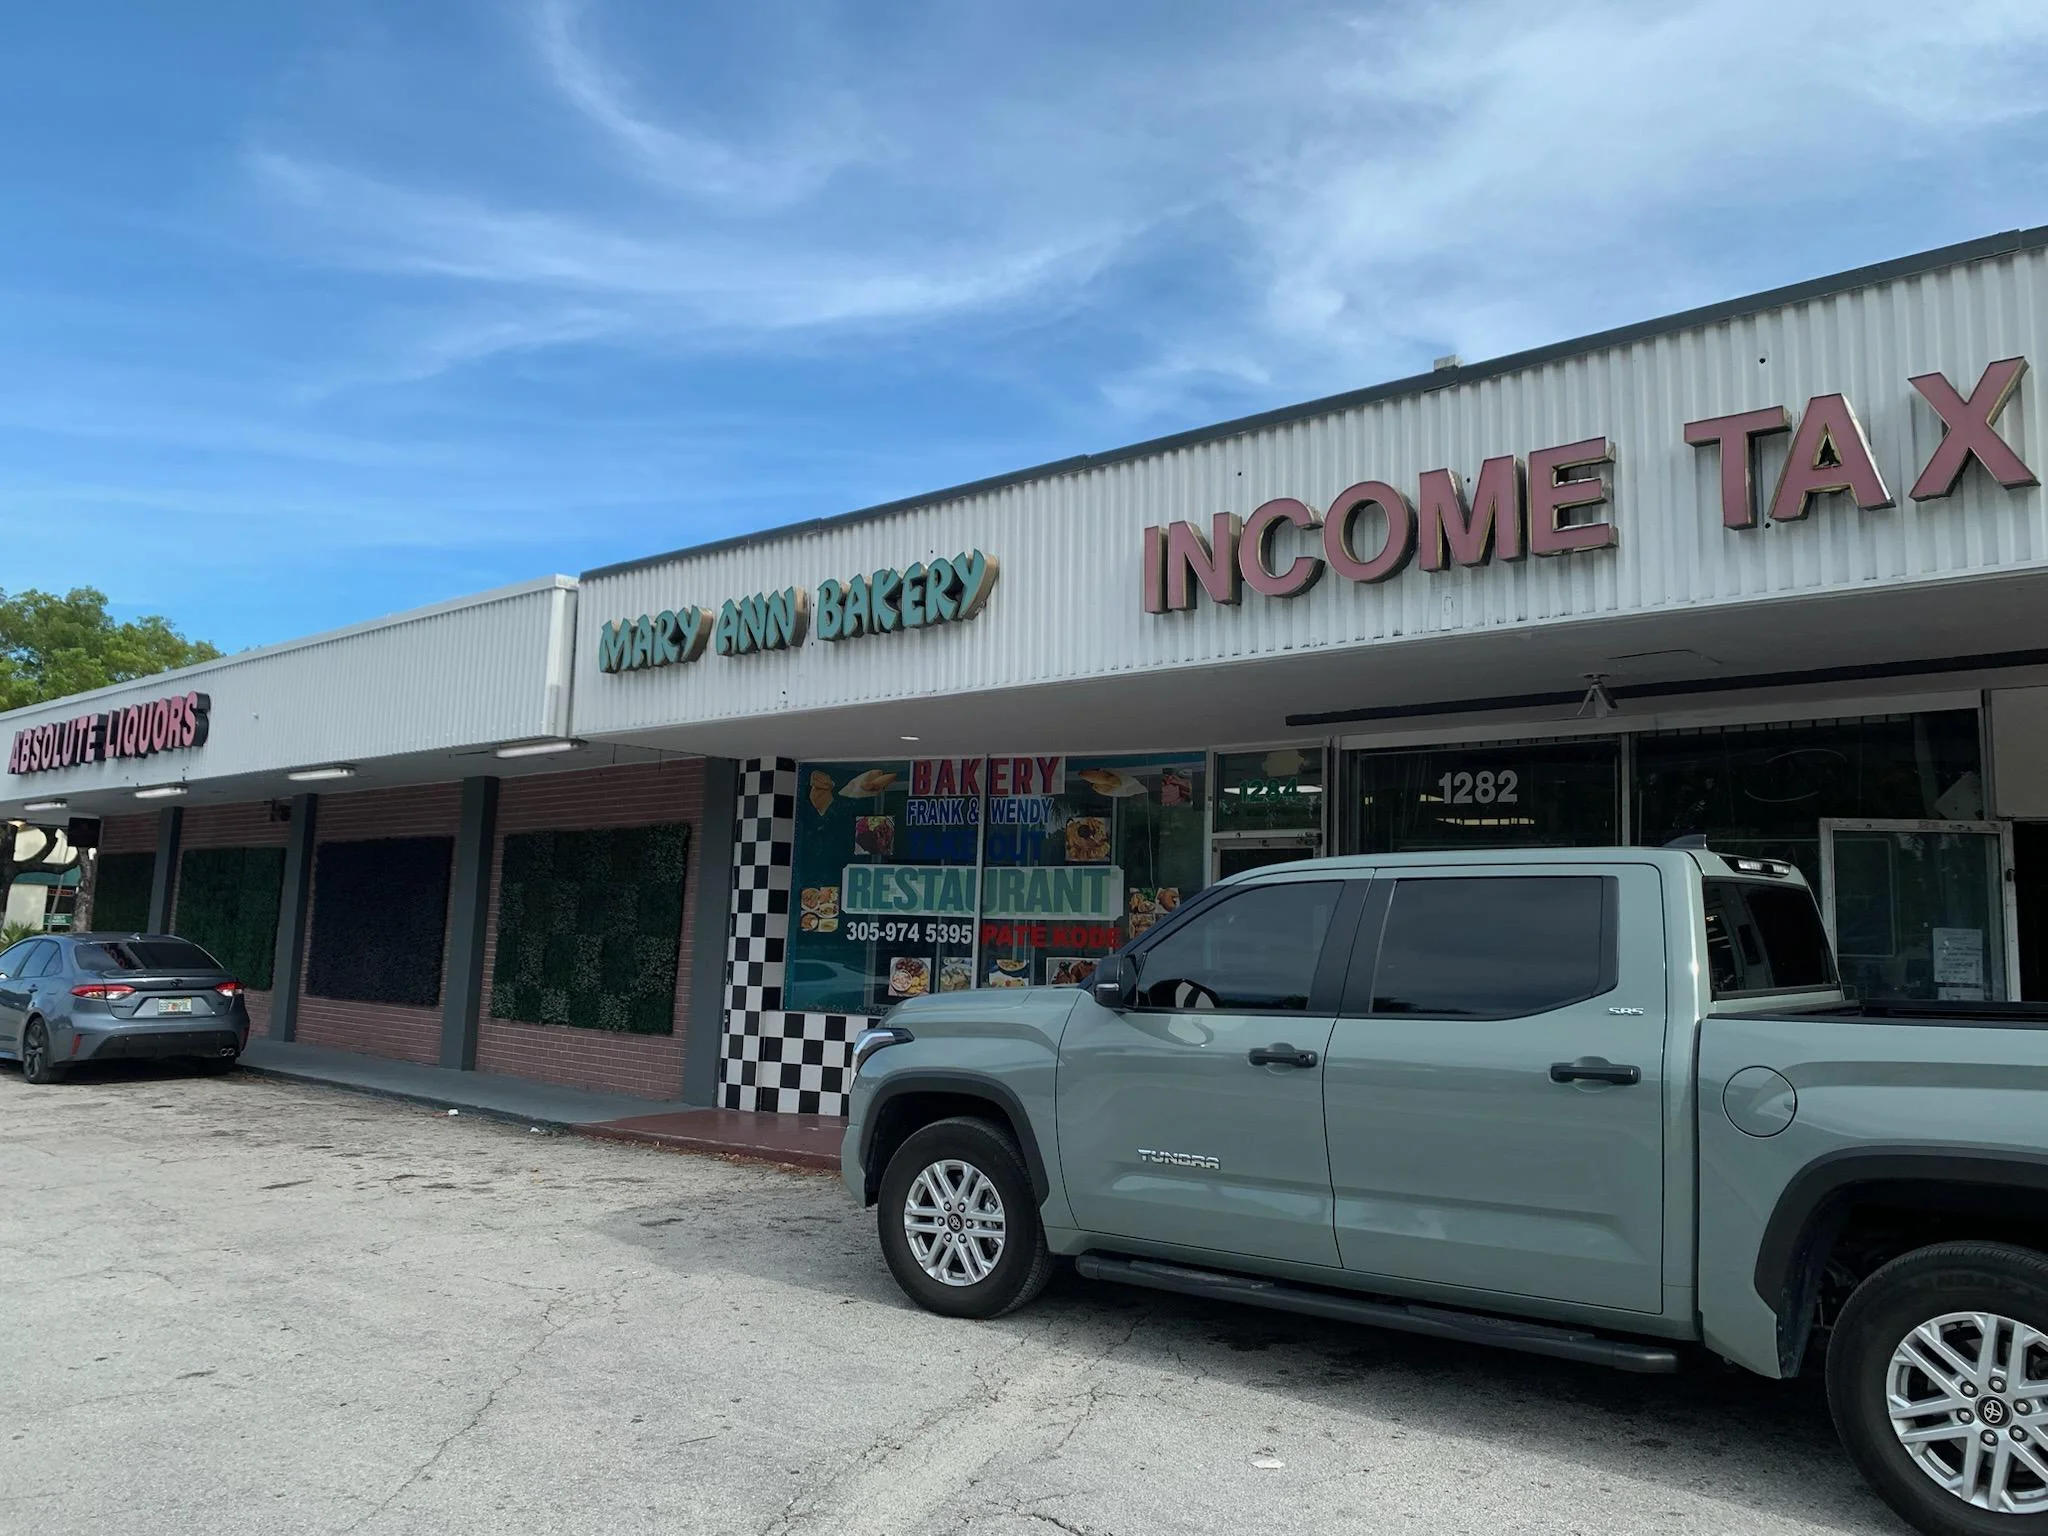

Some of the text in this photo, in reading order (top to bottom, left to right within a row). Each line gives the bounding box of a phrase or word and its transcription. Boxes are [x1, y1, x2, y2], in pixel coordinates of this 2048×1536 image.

[1144, 356, 2041, 614] INCOME TAX
[600, 549, 996, 673] MARY ANN BAKERY
[8, 691, 204, 775] ABSOLUTE LIQUORS
[912, 757, 1061, 796] BAKERY
[1240, 777, 1299, 804] 1284
[1439, 769, 1518, 804] 1282
[907, 797, 1054, 825] FRANK & WENDY
[846, 866, 1112, 916] RESTAURANT
[846, 922, 973, 945] 305-974 5395
[981, 923, 1047, 947] PATE
[1138, 1148, 1221, 1170] TUNDRA
